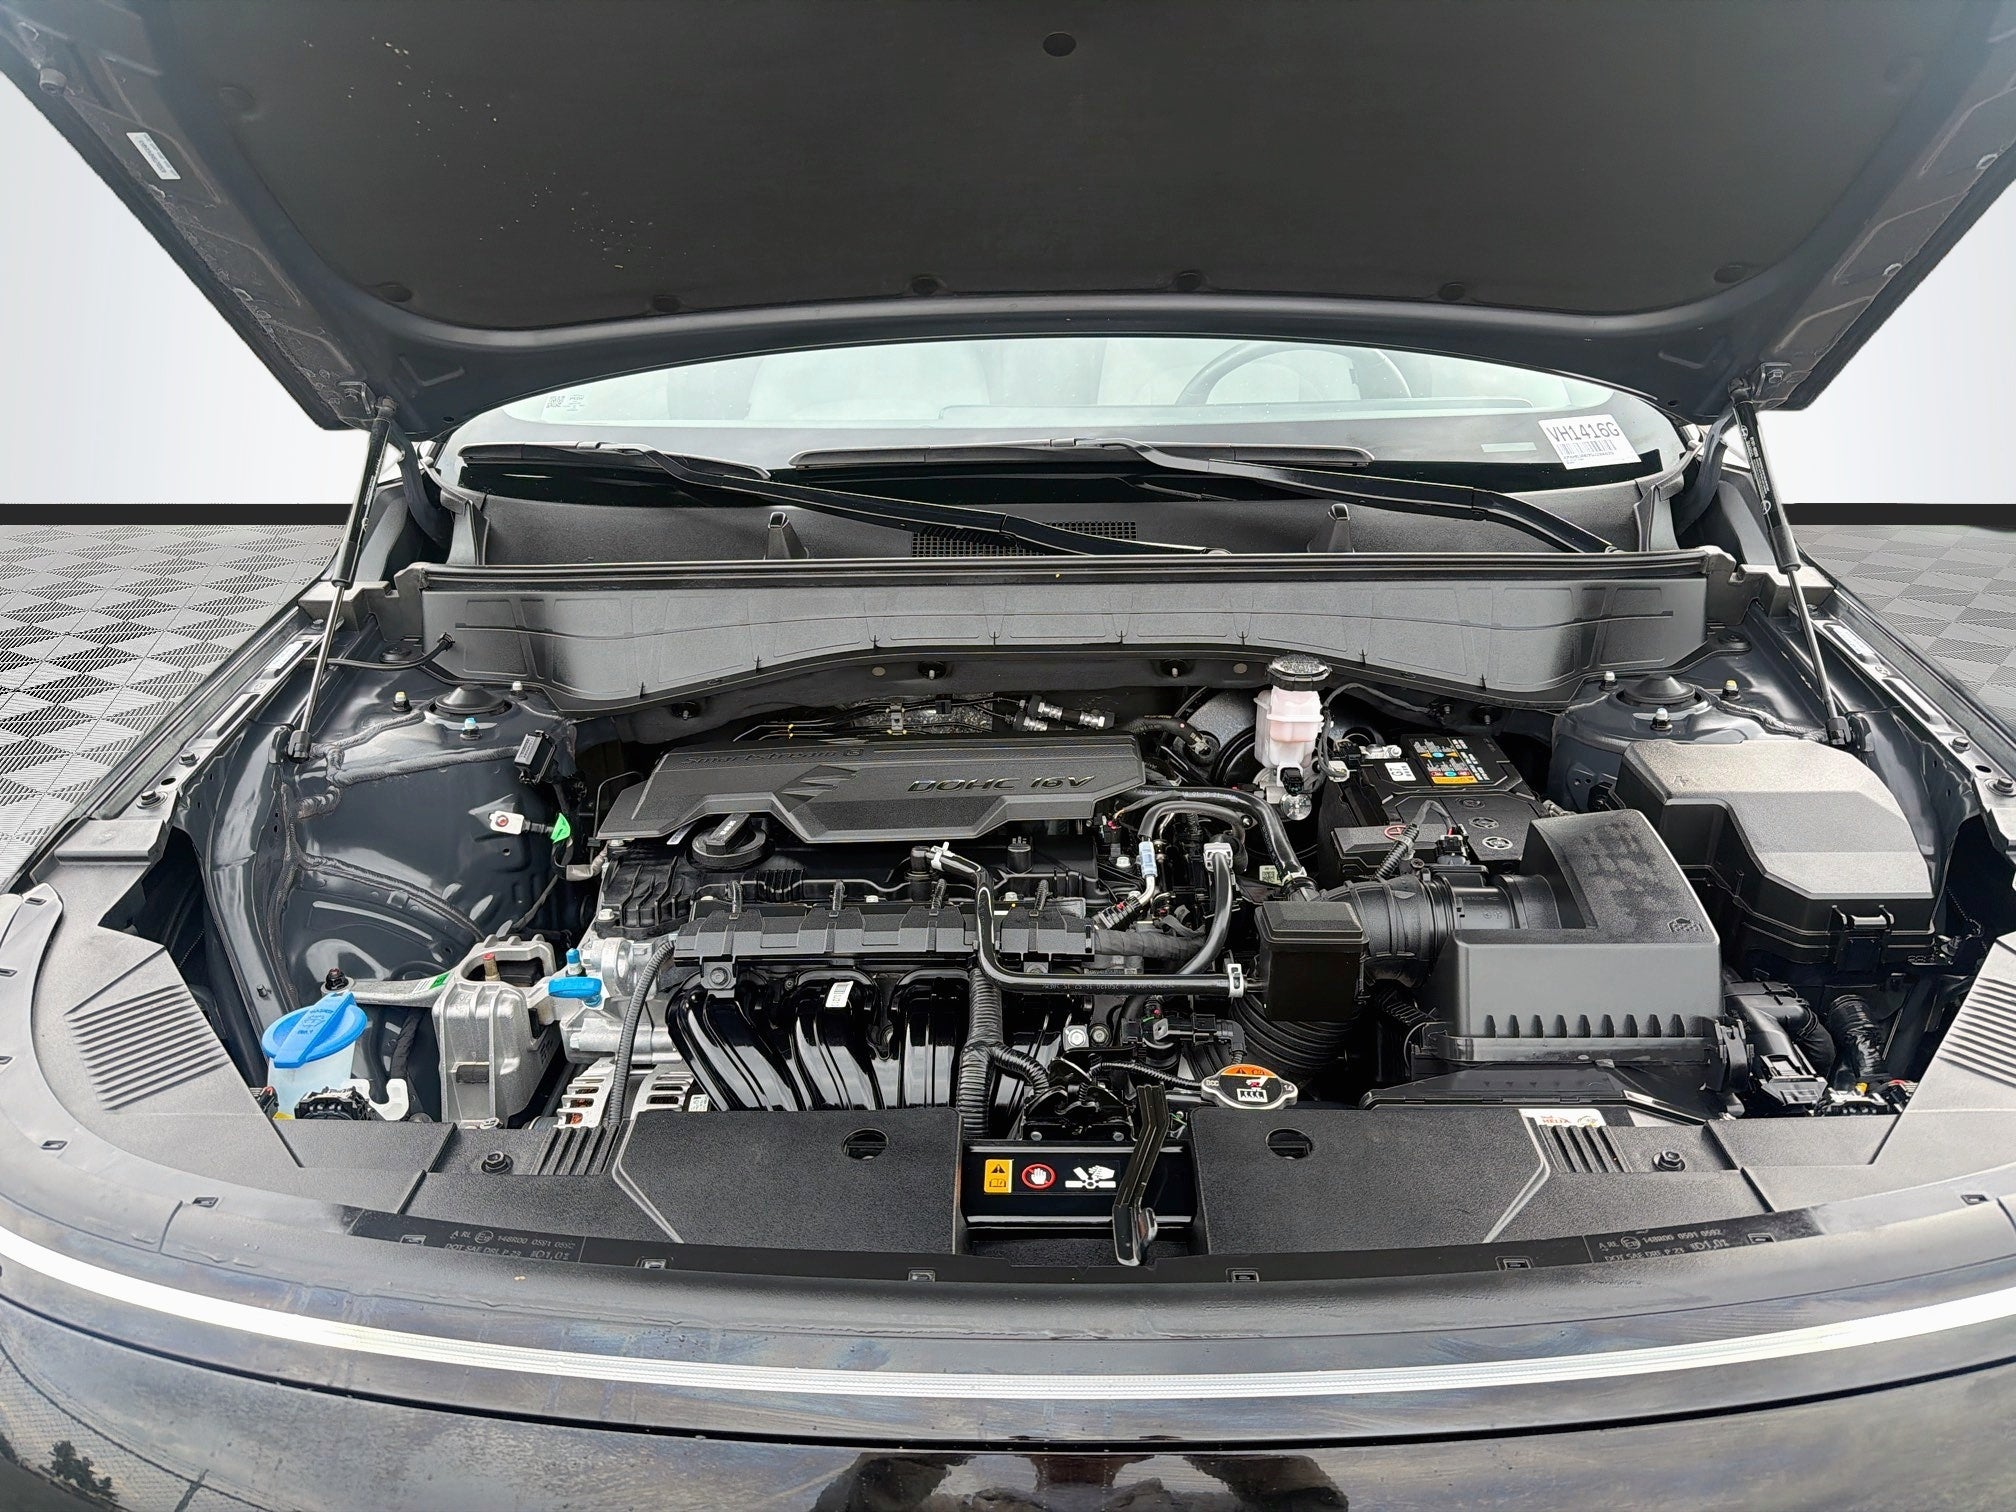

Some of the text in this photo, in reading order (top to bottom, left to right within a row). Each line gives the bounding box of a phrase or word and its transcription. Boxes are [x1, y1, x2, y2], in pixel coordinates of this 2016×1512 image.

[1546, 422, 1620, 442] VH1416G
[907, 775, 1097, 792] DOHC 16V
